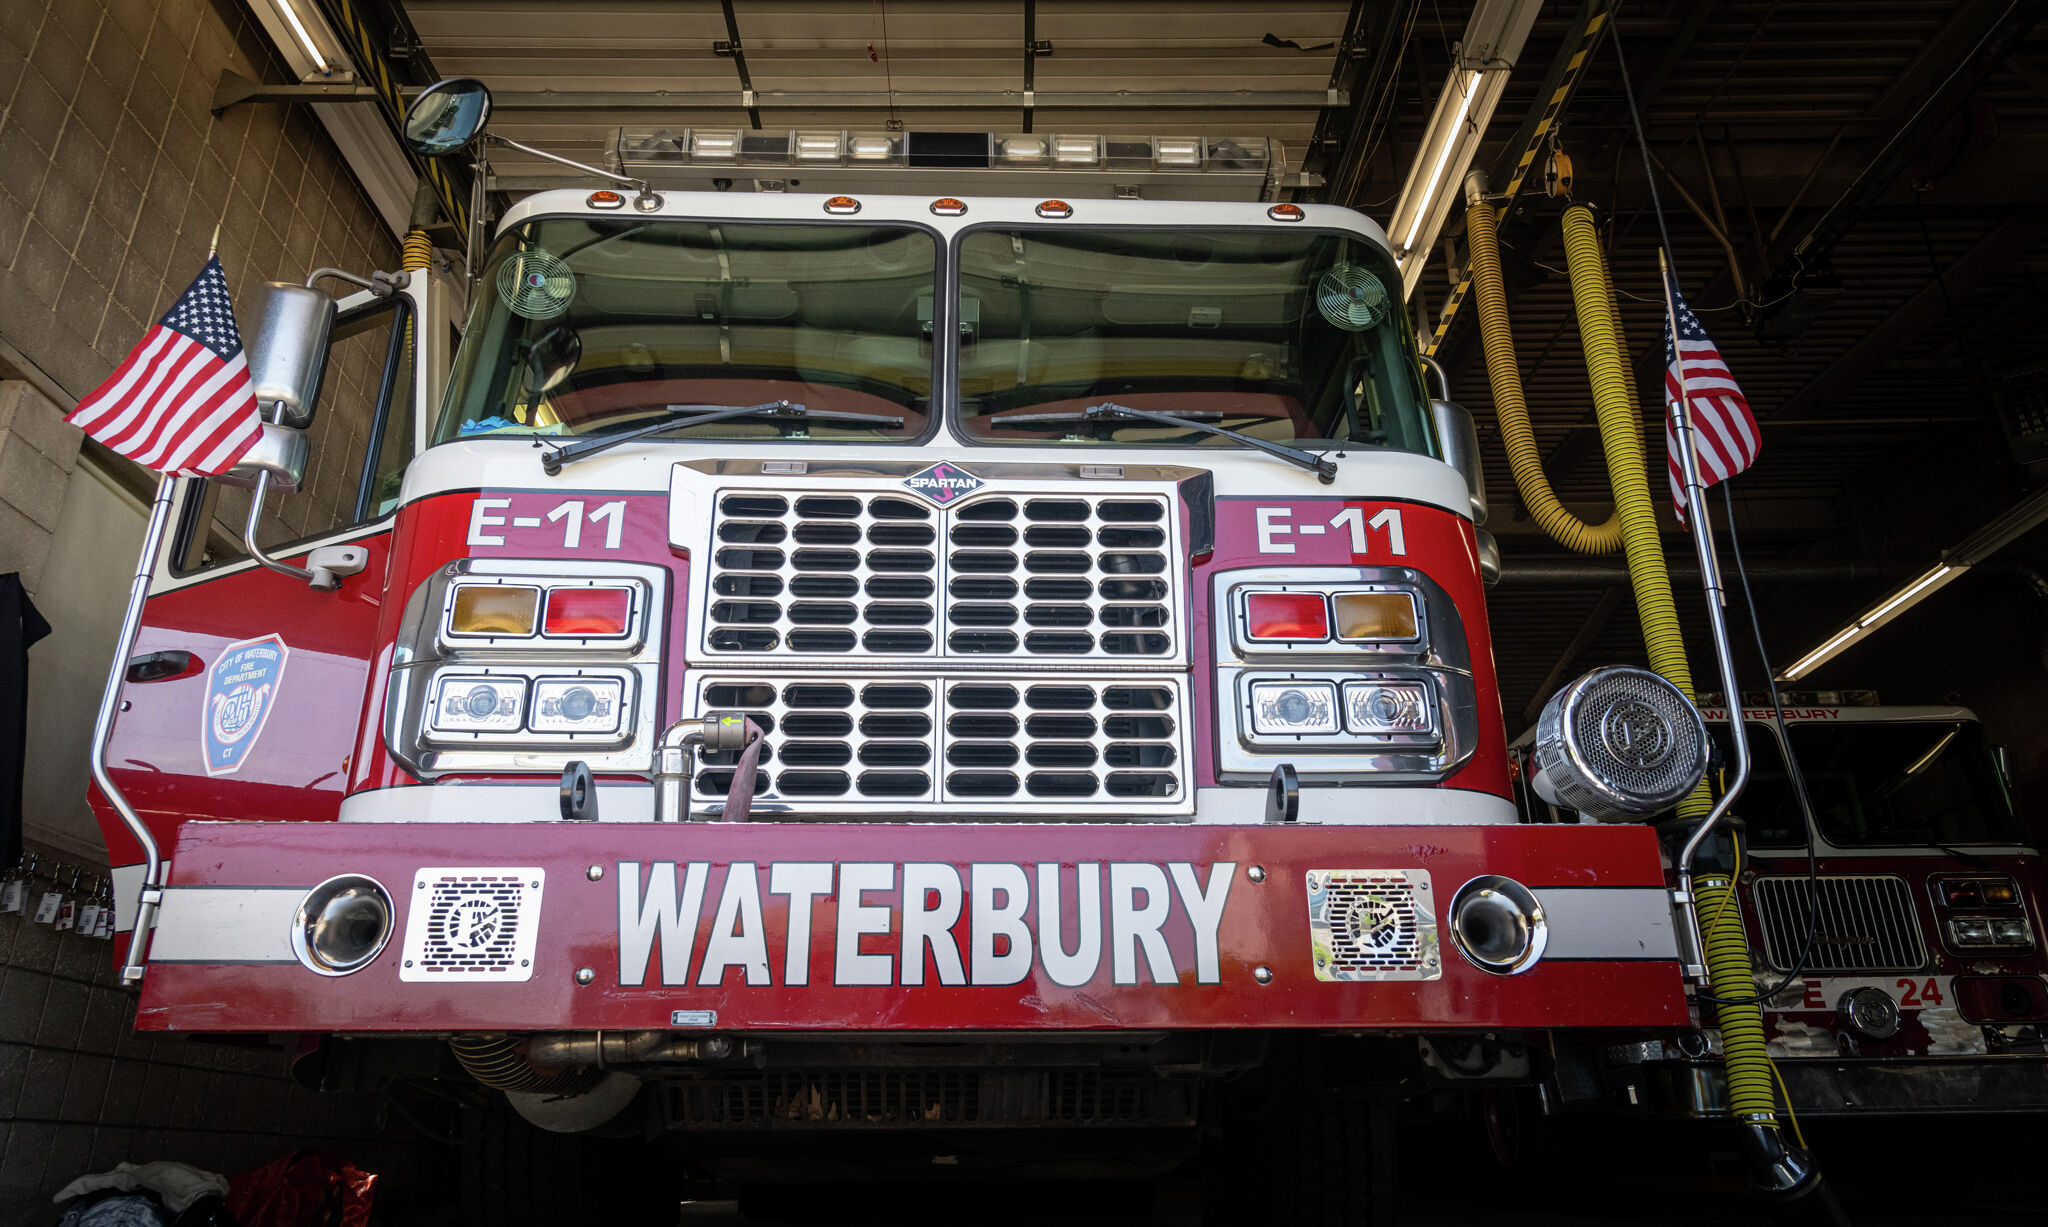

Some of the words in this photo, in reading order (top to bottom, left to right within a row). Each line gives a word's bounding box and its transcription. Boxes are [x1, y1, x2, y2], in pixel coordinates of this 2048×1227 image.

[910, 478, 977, 488] SPARTAN
[466, 496, 627, 550] E-11
[1255, 506, 1407, 557] E-11
[219, 660, 234, 673] CITY
[235, 652, 245, 663] OF
[245, 648, 278, 662] WATERBURY
[240, 662, 254, 673] FIRE
[224, 668, 267, 685] DEPARTMENT
[1702, 709, 1840, 720] WTERBURY
[222, 748, 234, 758] CT
[617, 860, 1239, 987] WATERBURY
[1803, 980, 1827, 1009] E
[1896, 977, 1944, 1007] 24
